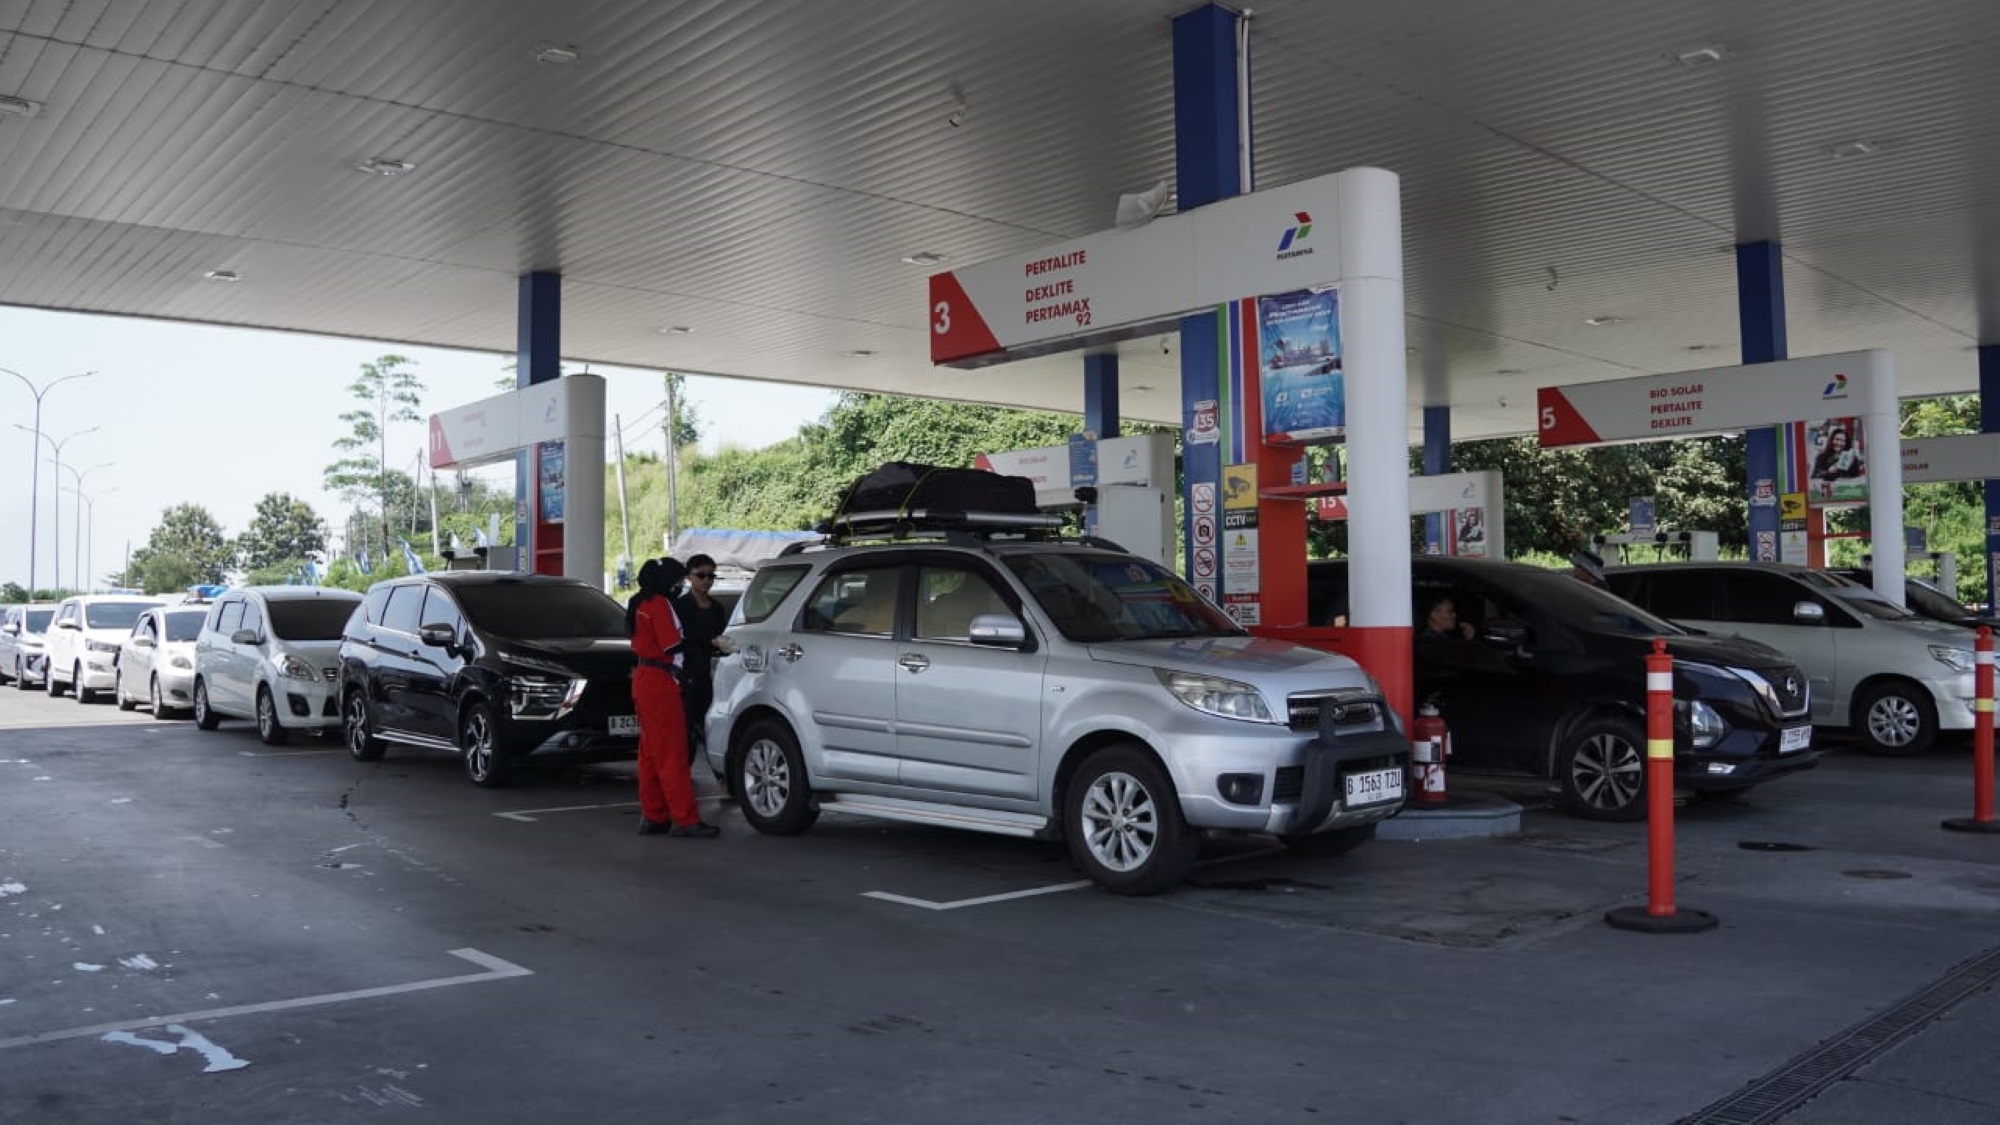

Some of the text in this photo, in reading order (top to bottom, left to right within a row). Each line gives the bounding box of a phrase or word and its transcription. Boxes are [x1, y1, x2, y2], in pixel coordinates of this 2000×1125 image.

[1025, 250, 1086, 278] PERTALITE
[1025, 279, 1074, 303] DEXLITE
[934, 300, 951, 335] 3
[1025, 298, 1090, 324] PERTAMAX
[1075, 311, 1091, 327] 92
[1650, 383, 1704, 399] BIO SOLAR
[1542, 406, 1556, 430] 5
[1650, 400, 1702, 415] PERTALITE
[1650, 416, 1693, 429] DEXLITE
[1225, 514, 1246, 527] CCTV
[1347, 770, 1401, 796] B 1563 TZU
